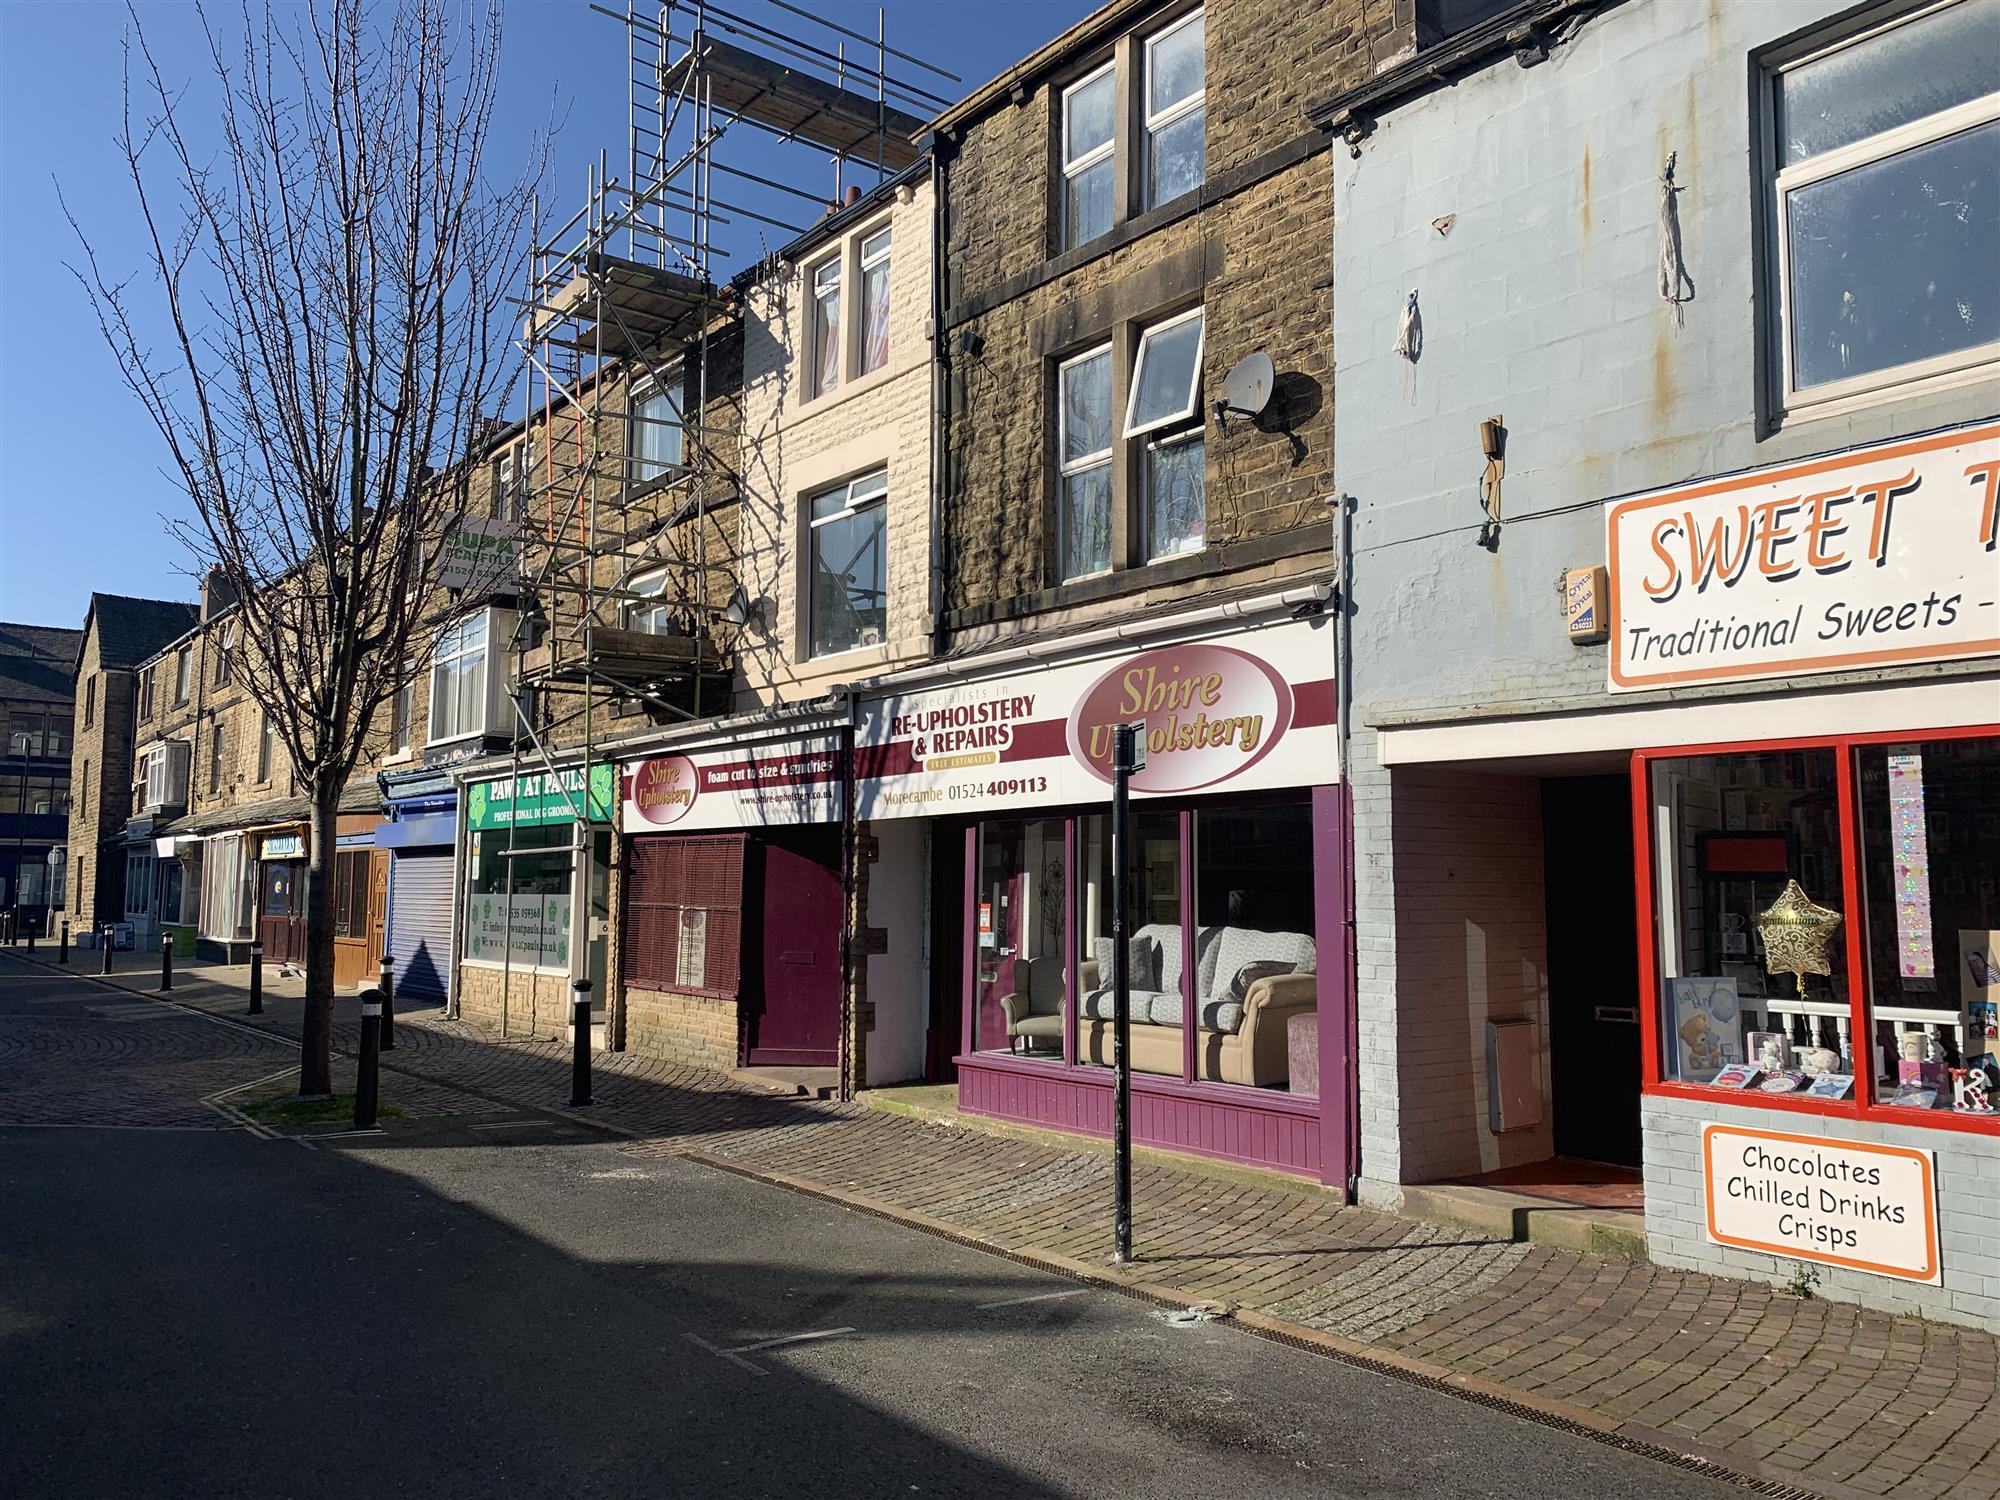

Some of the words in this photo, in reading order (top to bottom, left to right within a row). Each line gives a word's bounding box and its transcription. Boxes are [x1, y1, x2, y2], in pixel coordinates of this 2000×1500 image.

[1643, 467, 1922, 604] SWEET
[1569, 573, 1592, 597] Crystal
[1570, 590, 1593, 614] Crystal
[1629, 604, 1803, 661] Traditional
[1818, 592, 1962, 640] Sweets
[996, 684, 1009, 697] in
[1119, 665, 1223, 716] Shire
[891, 694, 1036, 737] RE-UPHOLSTERY
[914, 737, 927, 756] &
[933, 723, 1009, 753] REPAIRS
[1090, 712, 1264, 765] Uolstery
[648, 758, 680, 785] Shire
[707, 771, 729, 784] foam
[731, 769, 745, 783] cut
[747, 768, 756, 780] to
[758, 764, 778, 780] size
[780, 763, 788, 776] &
[789, 759, 833, 775] sundries
[931, 759, 948, 769] FREE
[951, 754, 992, 767] ESTIMATES
[523, 775, 541, 797] AT
[544, 768, 586, 795] PAULS
[638, 786, 692, 810] Upholstery
[883, 787, 943, 806] Morecambe
[948, 783, 984, 800] 01524
[987, 776, 1048, 796] 409113
[1742, 1146, 1881, 1186] Chocolates
[1727, 1176, 1810, 1209] Chilled
[1819, 1188, 1905, 1224] Drinks
[1778, 1214, 1858, 1251] Crisps
